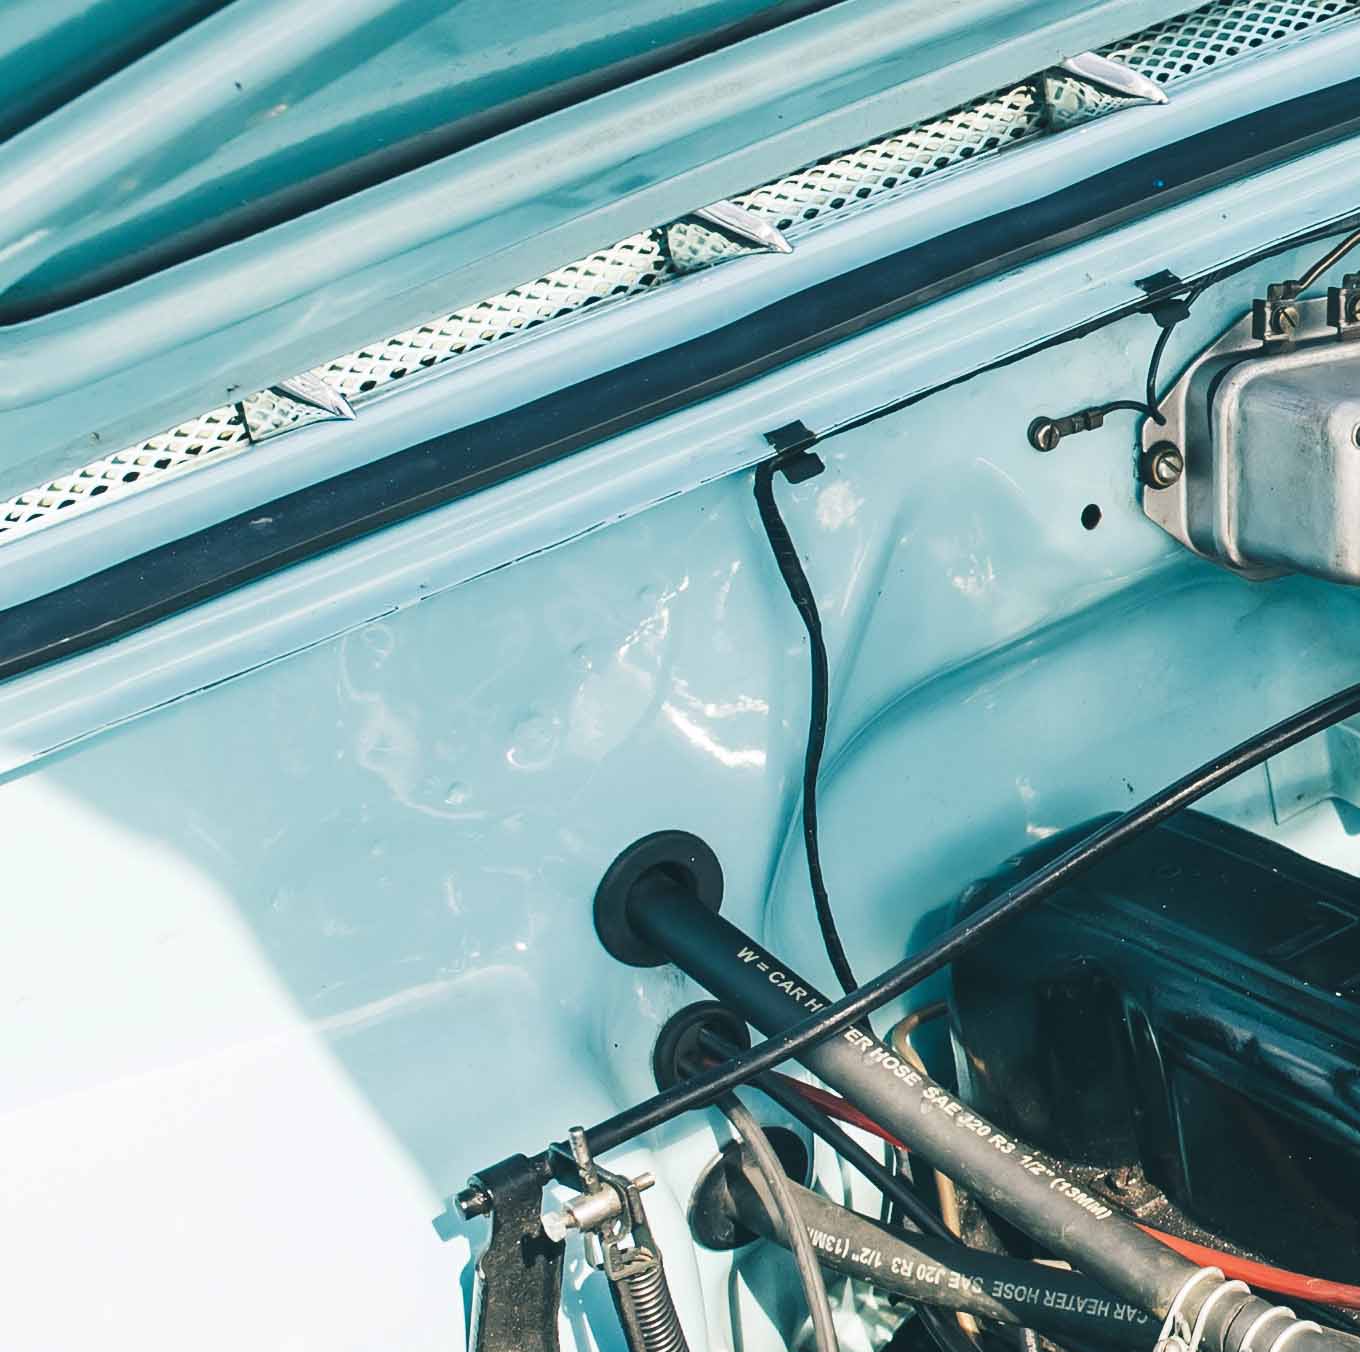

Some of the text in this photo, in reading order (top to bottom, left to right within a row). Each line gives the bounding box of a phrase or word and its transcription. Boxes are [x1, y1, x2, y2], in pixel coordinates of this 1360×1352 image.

[737, 946, 759, 963] W
[769, 971, 807, 1001] CAR
[870, 1046, 922, 1086] HOSE
[923, 1086, 962, 1117] SAE
[958, 1110, 991, 1137] J20
[988, 1133, 1016, 1154] R3
[1049, 1177, 1113, 1220] (13MM)
[851, 1247, 883, 1270] 1/2"
[891, 1257, 914, 1277] R3
[916, 1263, 947, 1284] J20
[948, 1272, 984, 1294] SAE
[992, 1280, 1040, 1304] HOSE
[1042, 1290, 1111, 1320] HEATER
[1113, 1302, 1149, 1324] CAR
